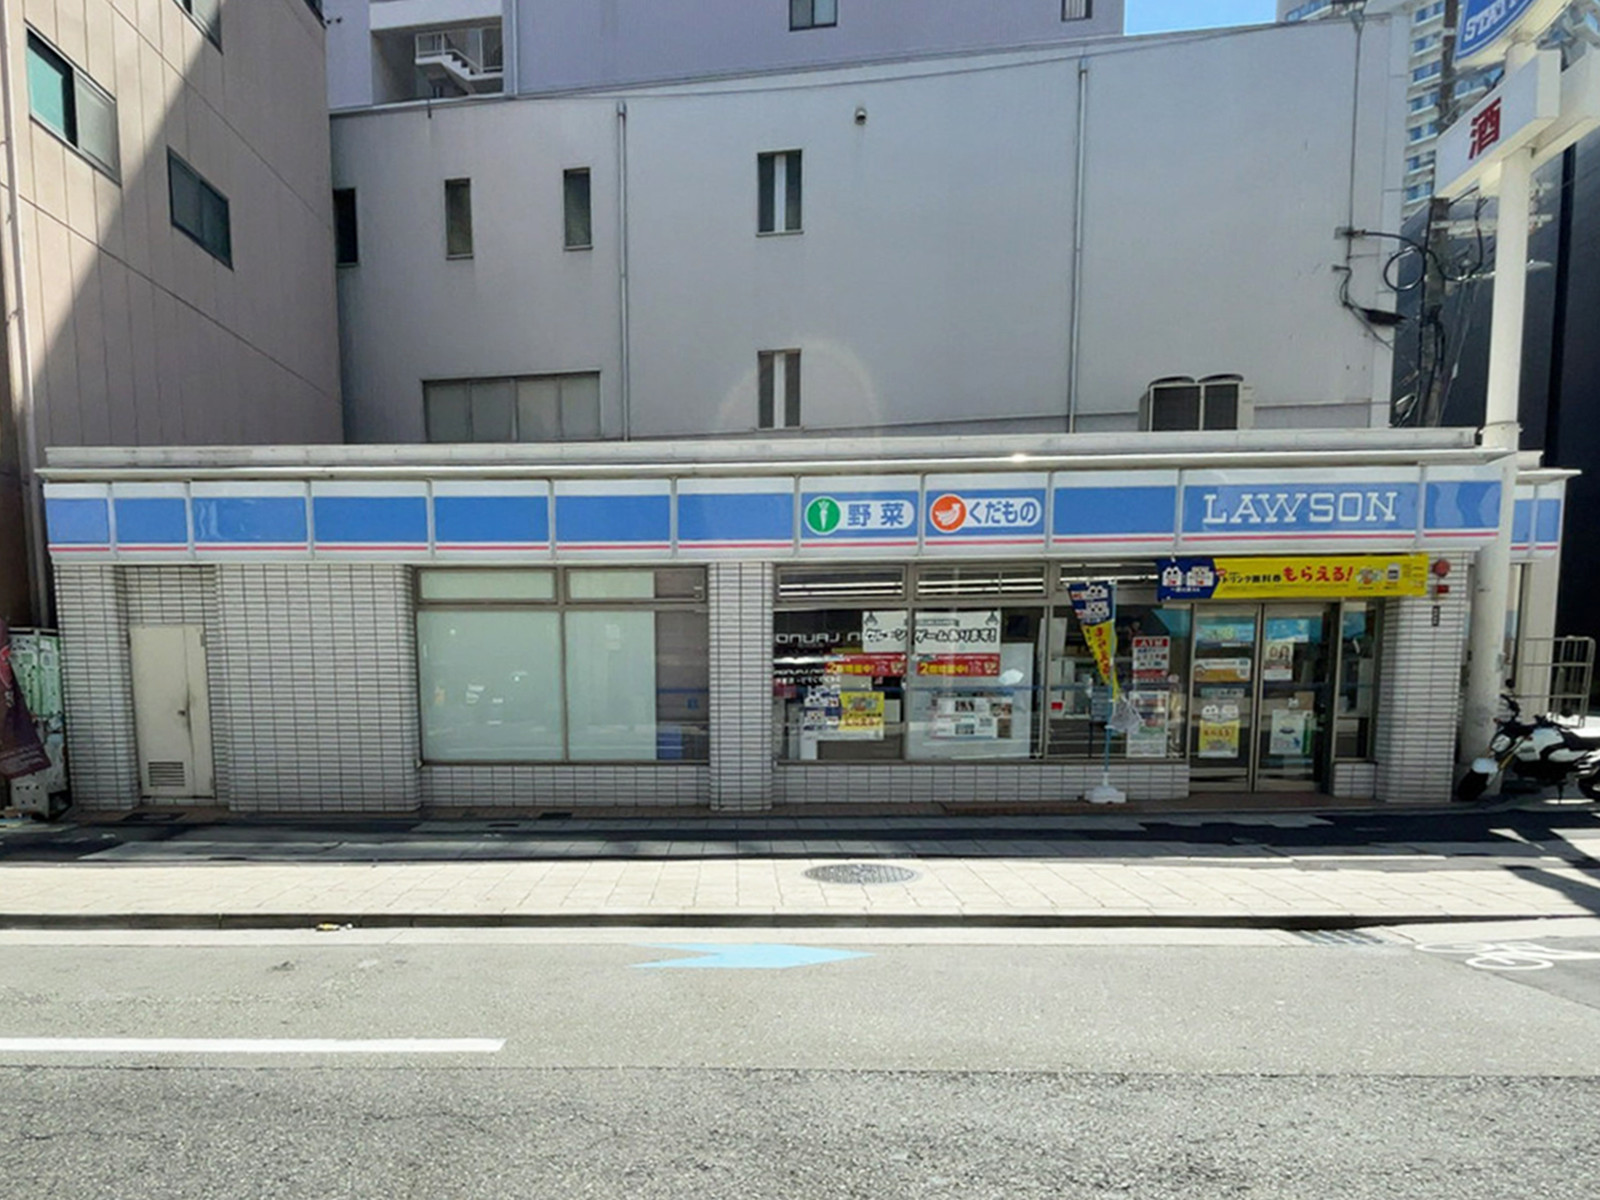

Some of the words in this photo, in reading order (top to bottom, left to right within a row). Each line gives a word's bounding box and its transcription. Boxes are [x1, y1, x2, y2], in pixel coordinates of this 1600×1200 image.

[1468, 97, 1502, 160] 酒
[847, 502, 905, 527] 野菜
[968, 501, 1037, 524] くだもの
[1202, 491, 1398, 524] LAWSON
